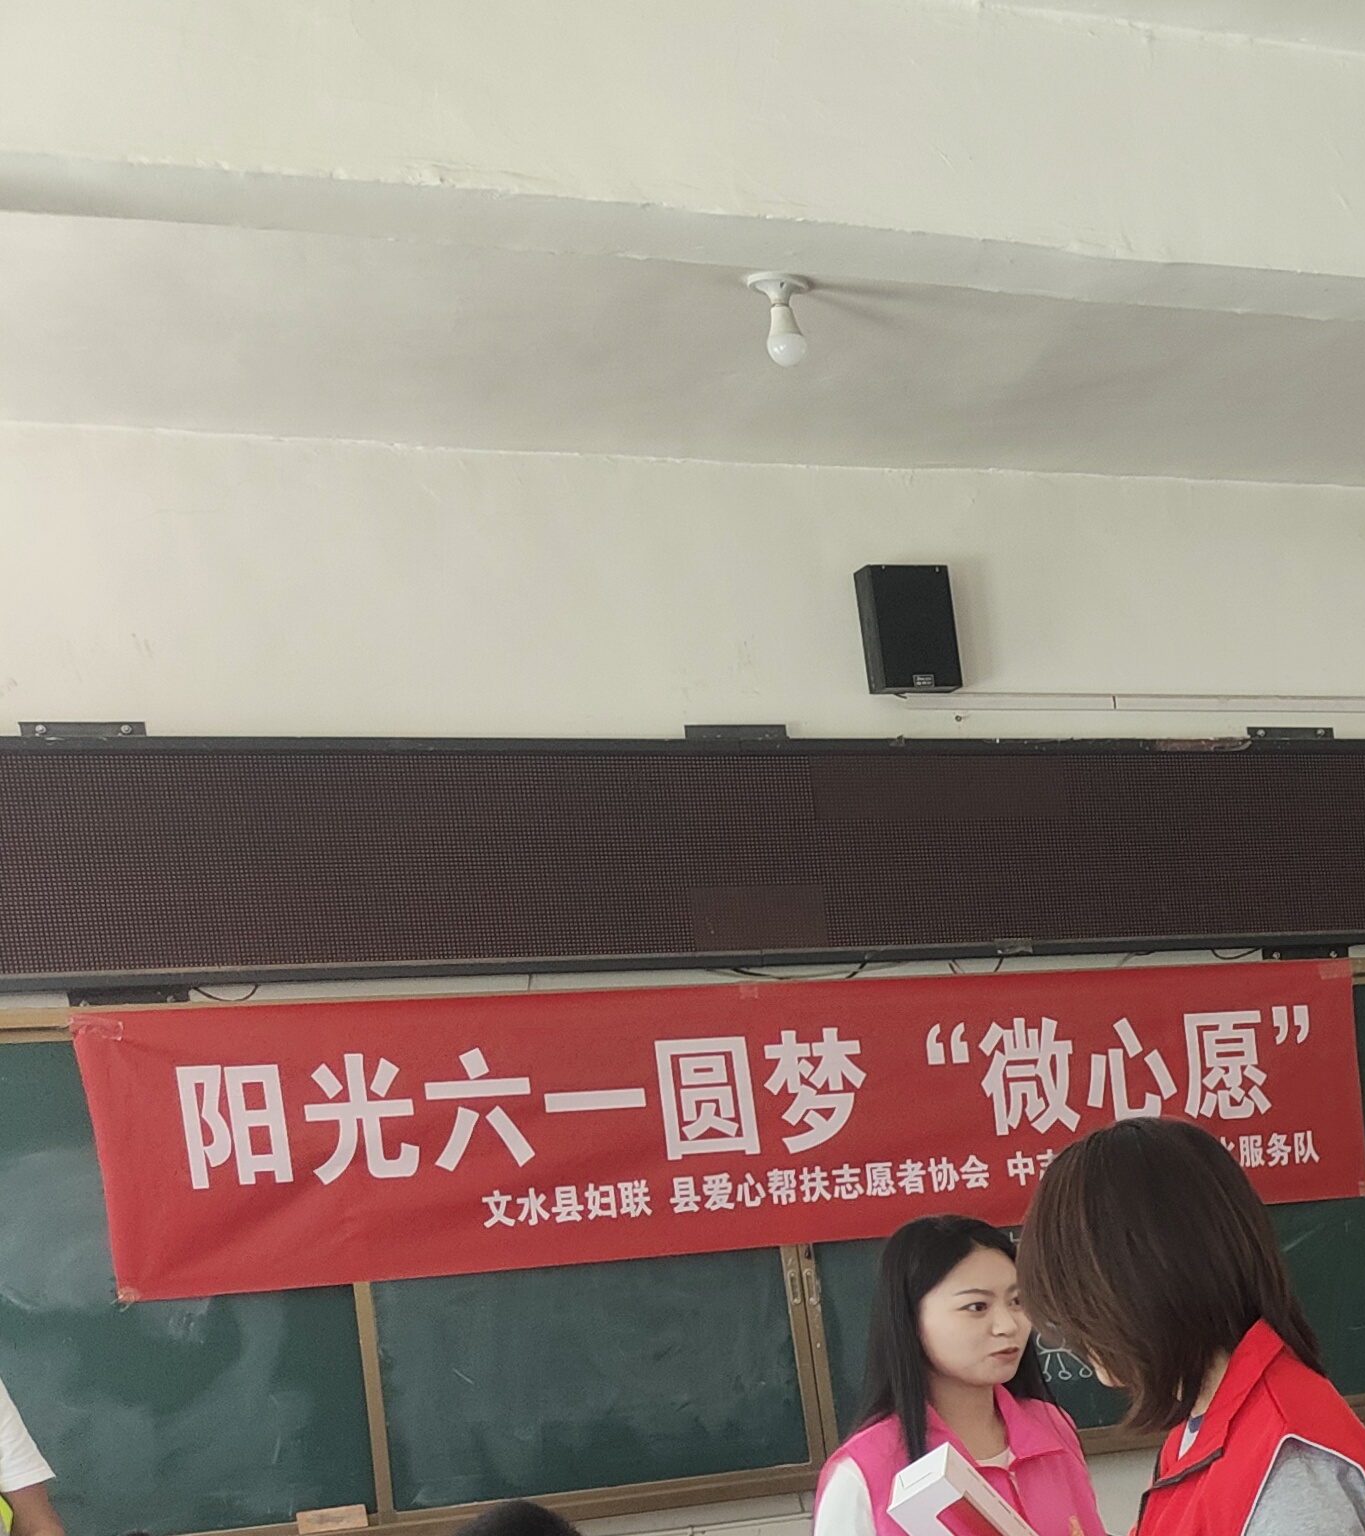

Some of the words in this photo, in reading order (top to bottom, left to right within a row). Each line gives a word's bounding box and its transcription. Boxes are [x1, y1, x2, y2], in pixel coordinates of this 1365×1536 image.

[482, 1179, 653, 1229] 文水县妇联
[669, 1154, 990, 1213] 县爱心帮扶志愿者协会
